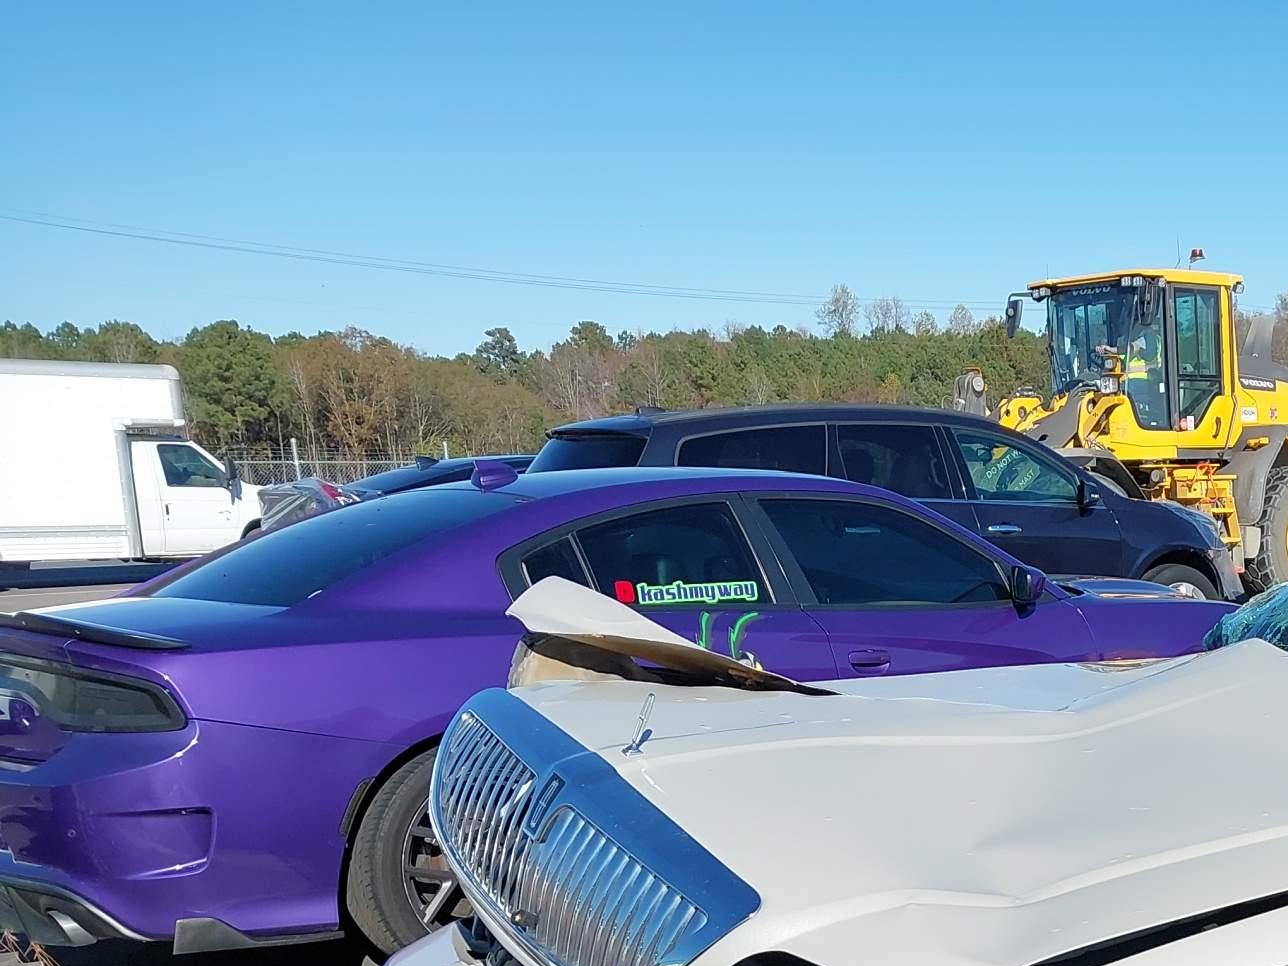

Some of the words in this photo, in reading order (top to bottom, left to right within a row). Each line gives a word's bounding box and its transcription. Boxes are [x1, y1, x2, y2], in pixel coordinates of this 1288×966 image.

[1239, 378, 1274, 389] VOLVO
[985, 466, 998, 479] DO
[995, 454, 1011, 471] NOT
[638, 581, 758, 604] kashmyway
